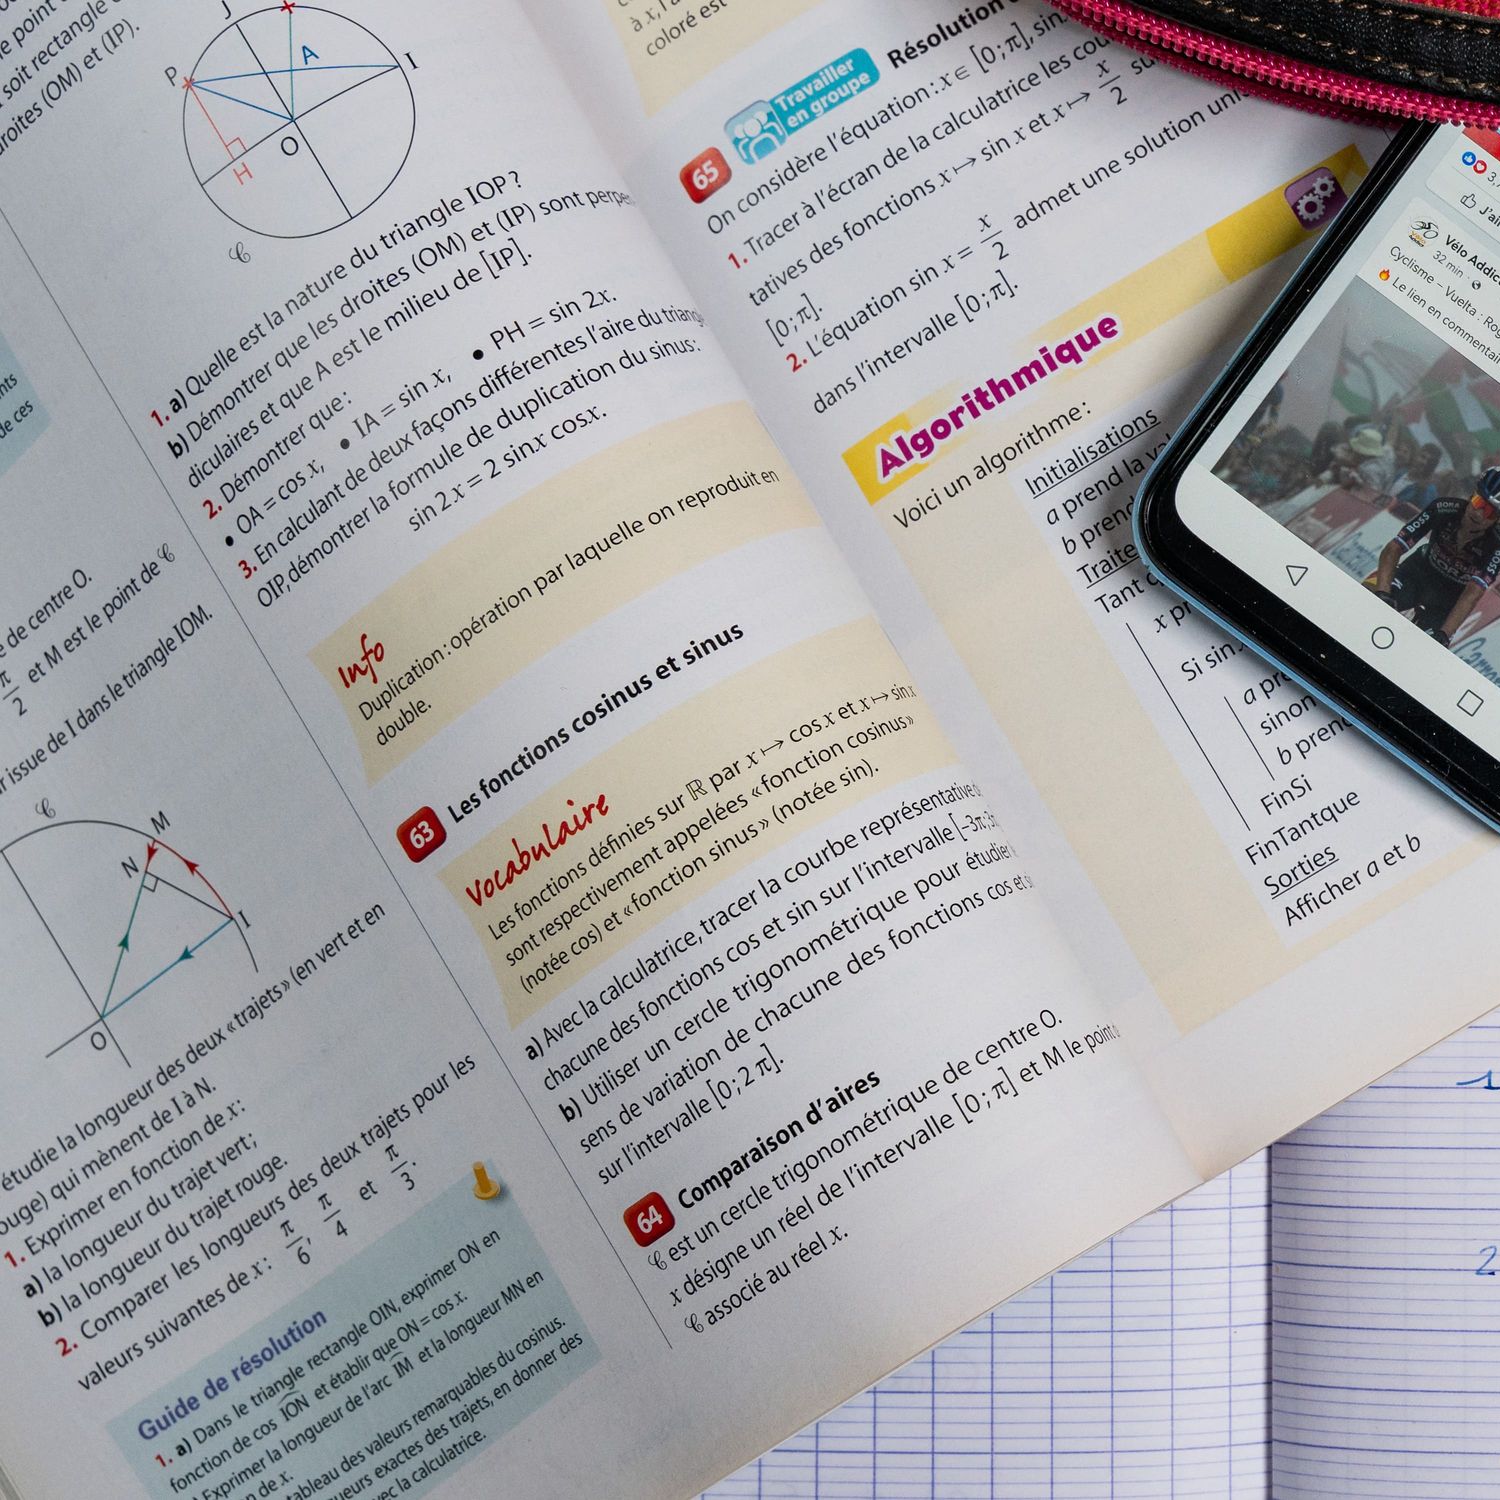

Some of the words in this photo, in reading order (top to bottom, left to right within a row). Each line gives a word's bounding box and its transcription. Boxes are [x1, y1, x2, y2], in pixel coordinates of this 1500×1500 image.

[775, 60, 854, 111] Travailler
[788, 110, 809, 127] en
[811, 74, 870, 117] groupe
[692, 160, 719, 189] 65
[1391, 246, 1435, 284] Cyclisme
[1446, 285, 1477, 317] Vuelta
[1432, 250, 1445, 262] 32
[1445, 262, 1464, 280] min
[1446, 234, 1468, 258] Vélo
[151, 410, 170, 428] 1.
[169, 389, 188, 414] a)
[186, 348, 239, 396] Quelle
[240, 323, 267, 352] est
[263, 311, 285, 330] la
[285, 265, 348, 316] nature
[350, 244, 379, 269] du
[379, 199, 466, 250] triangle
[1392, 277, 1407, 293] Le
[1407, 288, 1427, 308] lien
[1428, 306, 1442, 320] en
[189, 420, 260, 488] diculaires
[260, 403, 280, 425] et
[280, 376, 314, 409] que
[315, 361, 332, 382] A
[332, 339, 363, 367] est
[359, 327, 383, 346] le
[384, 285, 451, 332] milieu
[453, 268, 483, 291] de
[479, 237, 532, 280] [IP].
[881, 317, 1119, 479] Algorithmique
[1024, 407, 1160, 497] Initialisations
[1405, 511, 1431, 533] BOSS
[7, 626, 29, 649] de
[28, 585, 75, 630] centre
[72, 569, 92, 589] O.
[1094, 575, 1144, 614] Tant
[5, 749, 48, 785] issue
[47, 732, 69, 754] de
[64, 719, 78, 738] I
[77, 695, 111, 730] dans
[106, 683, 126, 702] le
[122, 637, 178, 689] triangle
[172, 605, 213, 644] IOM.
[337, 633, 385, 688] Info
[377, 700, 432, 746] double.
[447, 793, 482, 824] Les
[479, 728, 570, 800] fonctions
[572, 674, 653, 733] cosinus
[656, 656, 682, 680] et
[683, 624, 744, 666] sinus
[1244, 789, 1361, 866] FinTantque
[1260, 774, 1313, 815] FinSi
[408, 820, 436, 849] 63
[465, 794, 609, 906] Vocabulaire
[1263, 844, 1338, 898] Sorties
[1285, 870, 1362, 927] Afficher
[1367, 860, 1381, 878] a
[1383, 845, 1407, 867] et
[1405, 834, 1421, 853] b
[558, 1097, 583, 1123] b)
[581, 1056, 641, 1105] Utiliser
[644, 1039, 671, 1062] un
[674, 998, 731, 1042] cercle
[732, 890, 910, 1002] trigonométrique
[914, 862, 961, 901] pour
[678, 1120, 805, 1209] Comparaison
[806, 1071, 881, 1126] d'aires
[55, 1337, 79, 1357] 2.
[81, 1274, 169, 1340] Comparer
[171, 1256, 200, 1280] les
[200, 1196, 286, 1261] longueurs
[288, 1173, 318, 1201] des
[321, 1142, 362, 1178] deux
[361, 1104, 411, 1147] trajets
[412, 1073, 450, 1114] pour
[449, 1055, 476, 1080] les
[637, 1204, 663, 1232] 64
[138, 1396, 201, 1440] Guide
[204, 1377, 229, 1400] de
[231, 1311, 327, 1382] résolution
